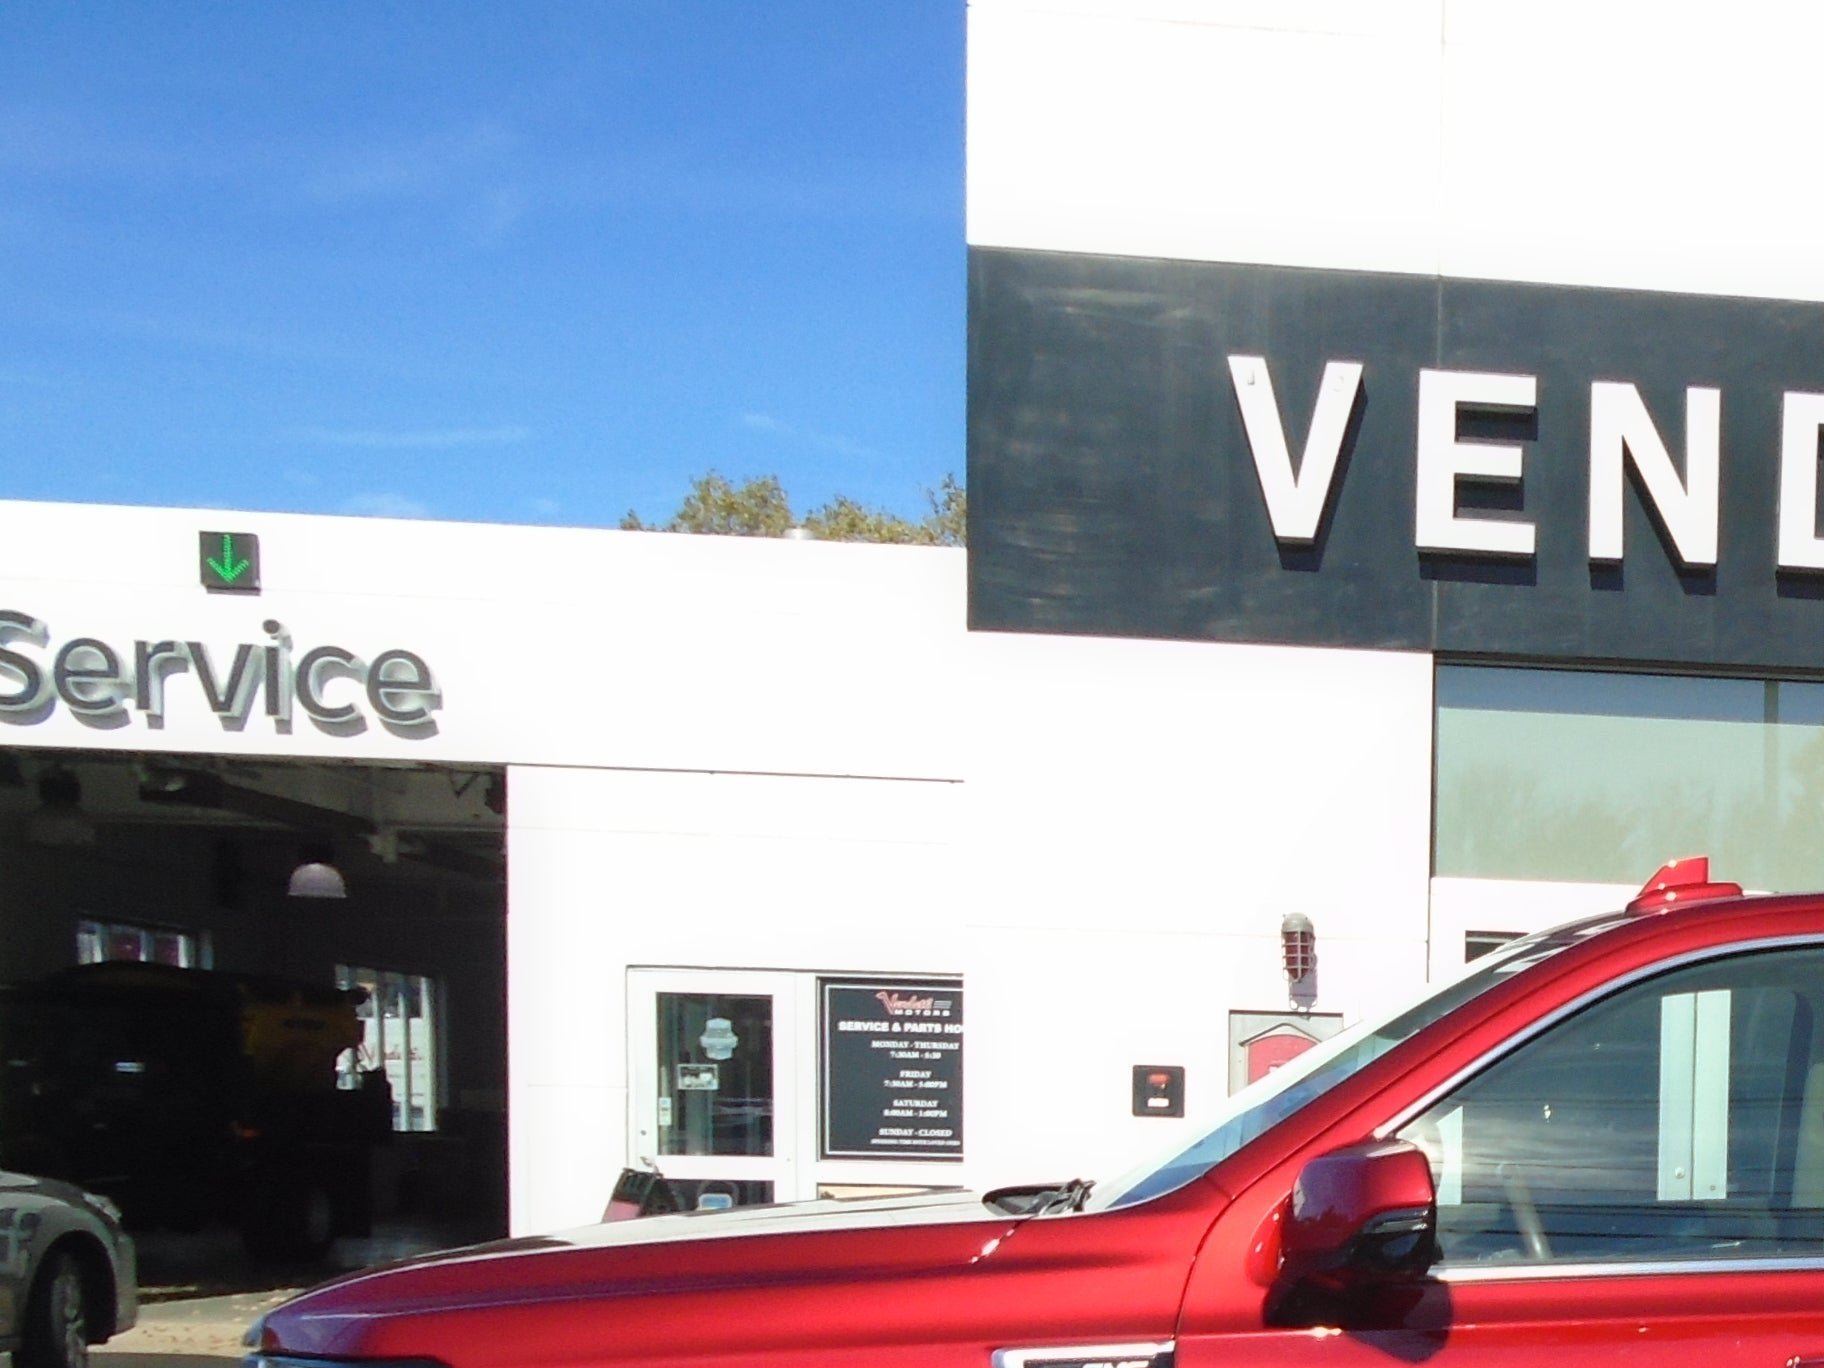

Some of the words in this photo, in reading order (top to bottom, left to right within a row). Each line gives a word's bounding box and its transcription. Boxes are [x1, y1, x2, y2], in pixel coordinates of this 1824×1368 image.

[0, 609, 442, 726] Service
[838, 1021, 889, 1032] SERVICE
[891, 1022, 902, 1032] &
[903, 1023, 942, 1033] PARTS
[871, 1040, 909, 1049] MONDAY
[914, 1041, 959, 1051] THURSDAY
[899, 1070, 931, 1078] FRIDAY
[893, 1100, 939, 1108] SATURDAY
[878, 1128, 914, 1136] SUNDAY
[918, 1128, 953, 1137] CLOSED
